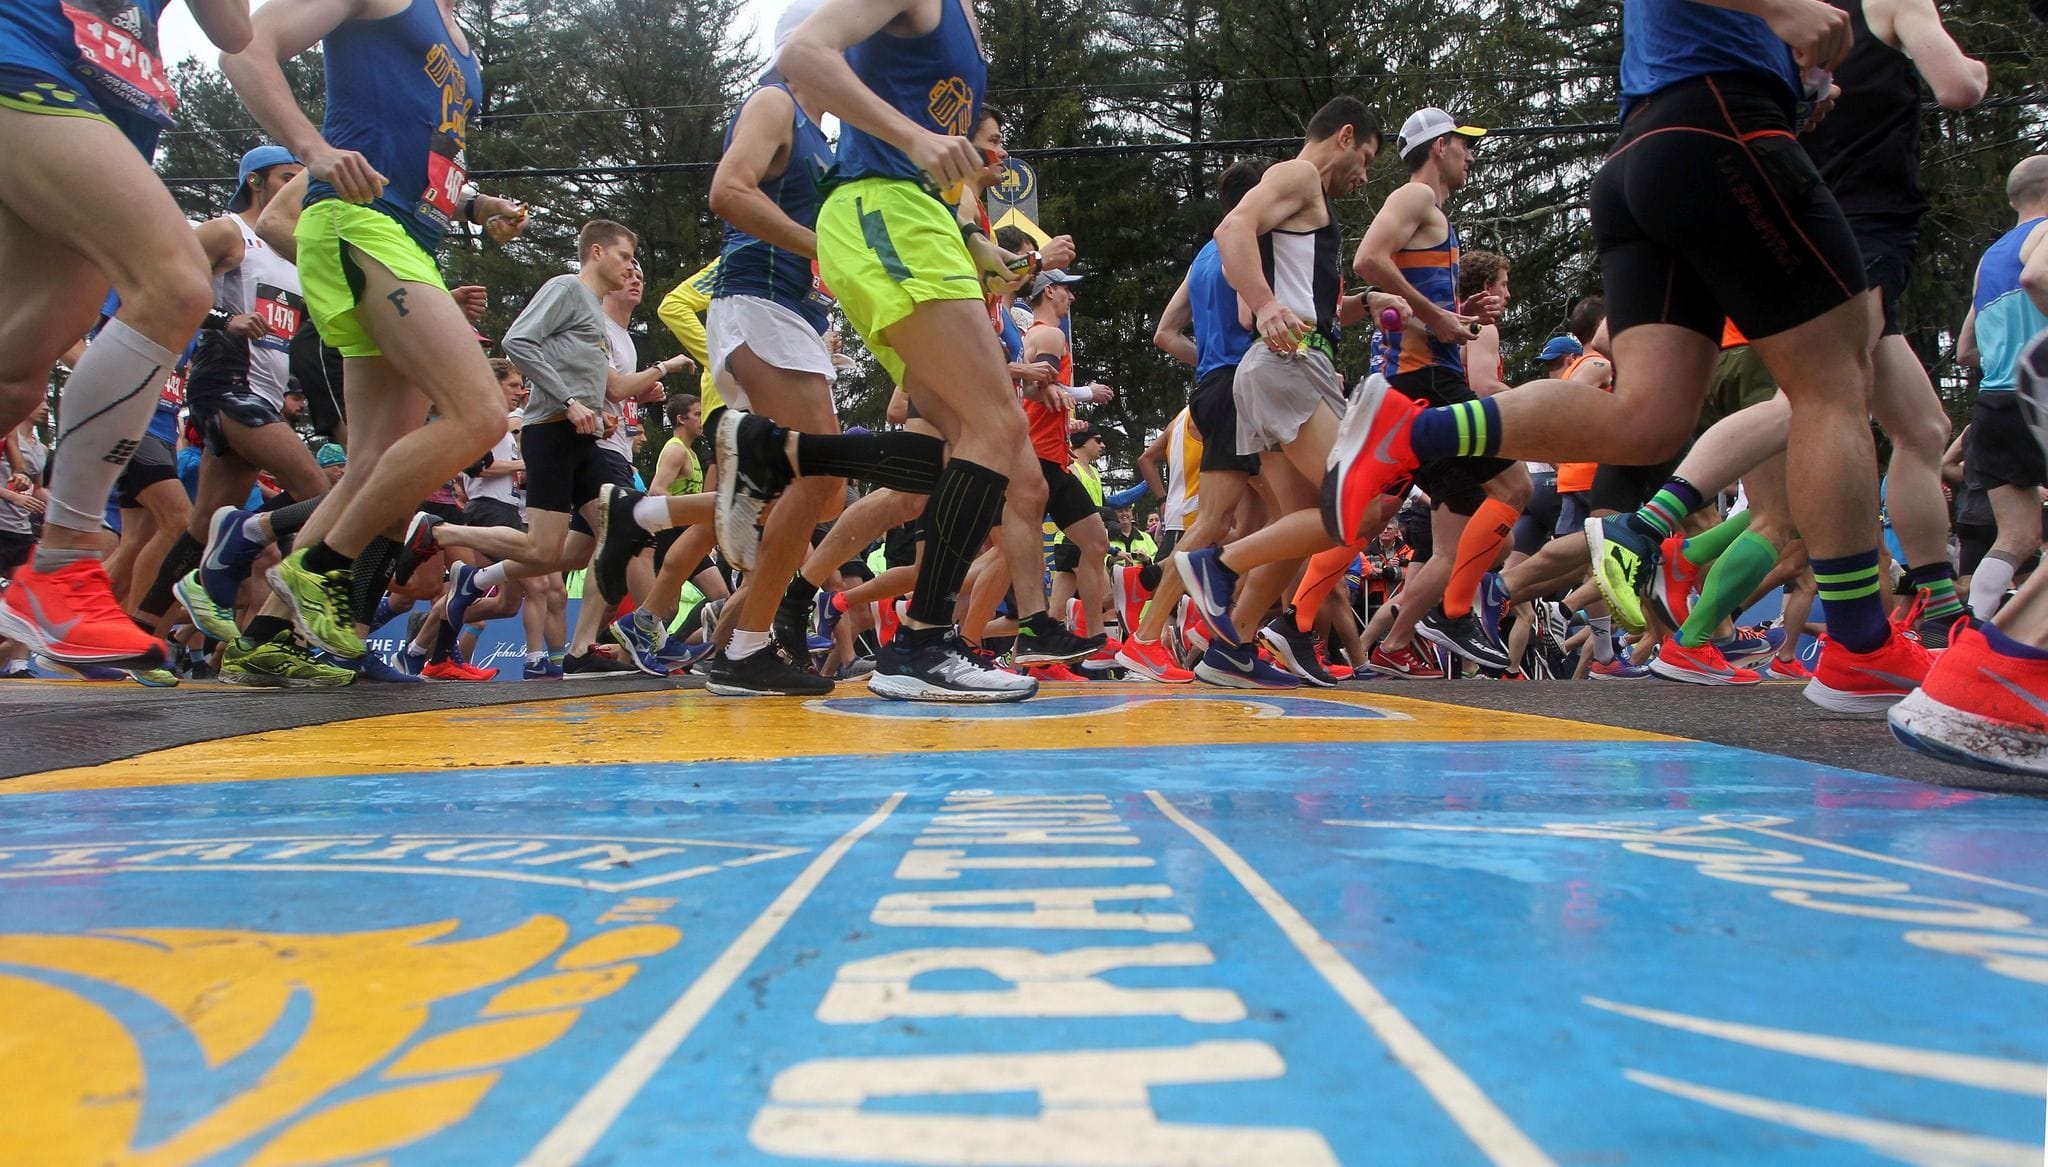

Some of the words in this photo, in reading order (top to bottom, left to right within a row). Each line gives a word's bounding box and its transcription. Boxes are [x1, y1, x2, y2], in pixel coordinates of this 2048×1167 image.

[120, 82, 152, 102] BOSTON
[386, 288, 410, 317] F
[266, 303, 295, 333] 1479
[0, 840, 686, 870] IATION
